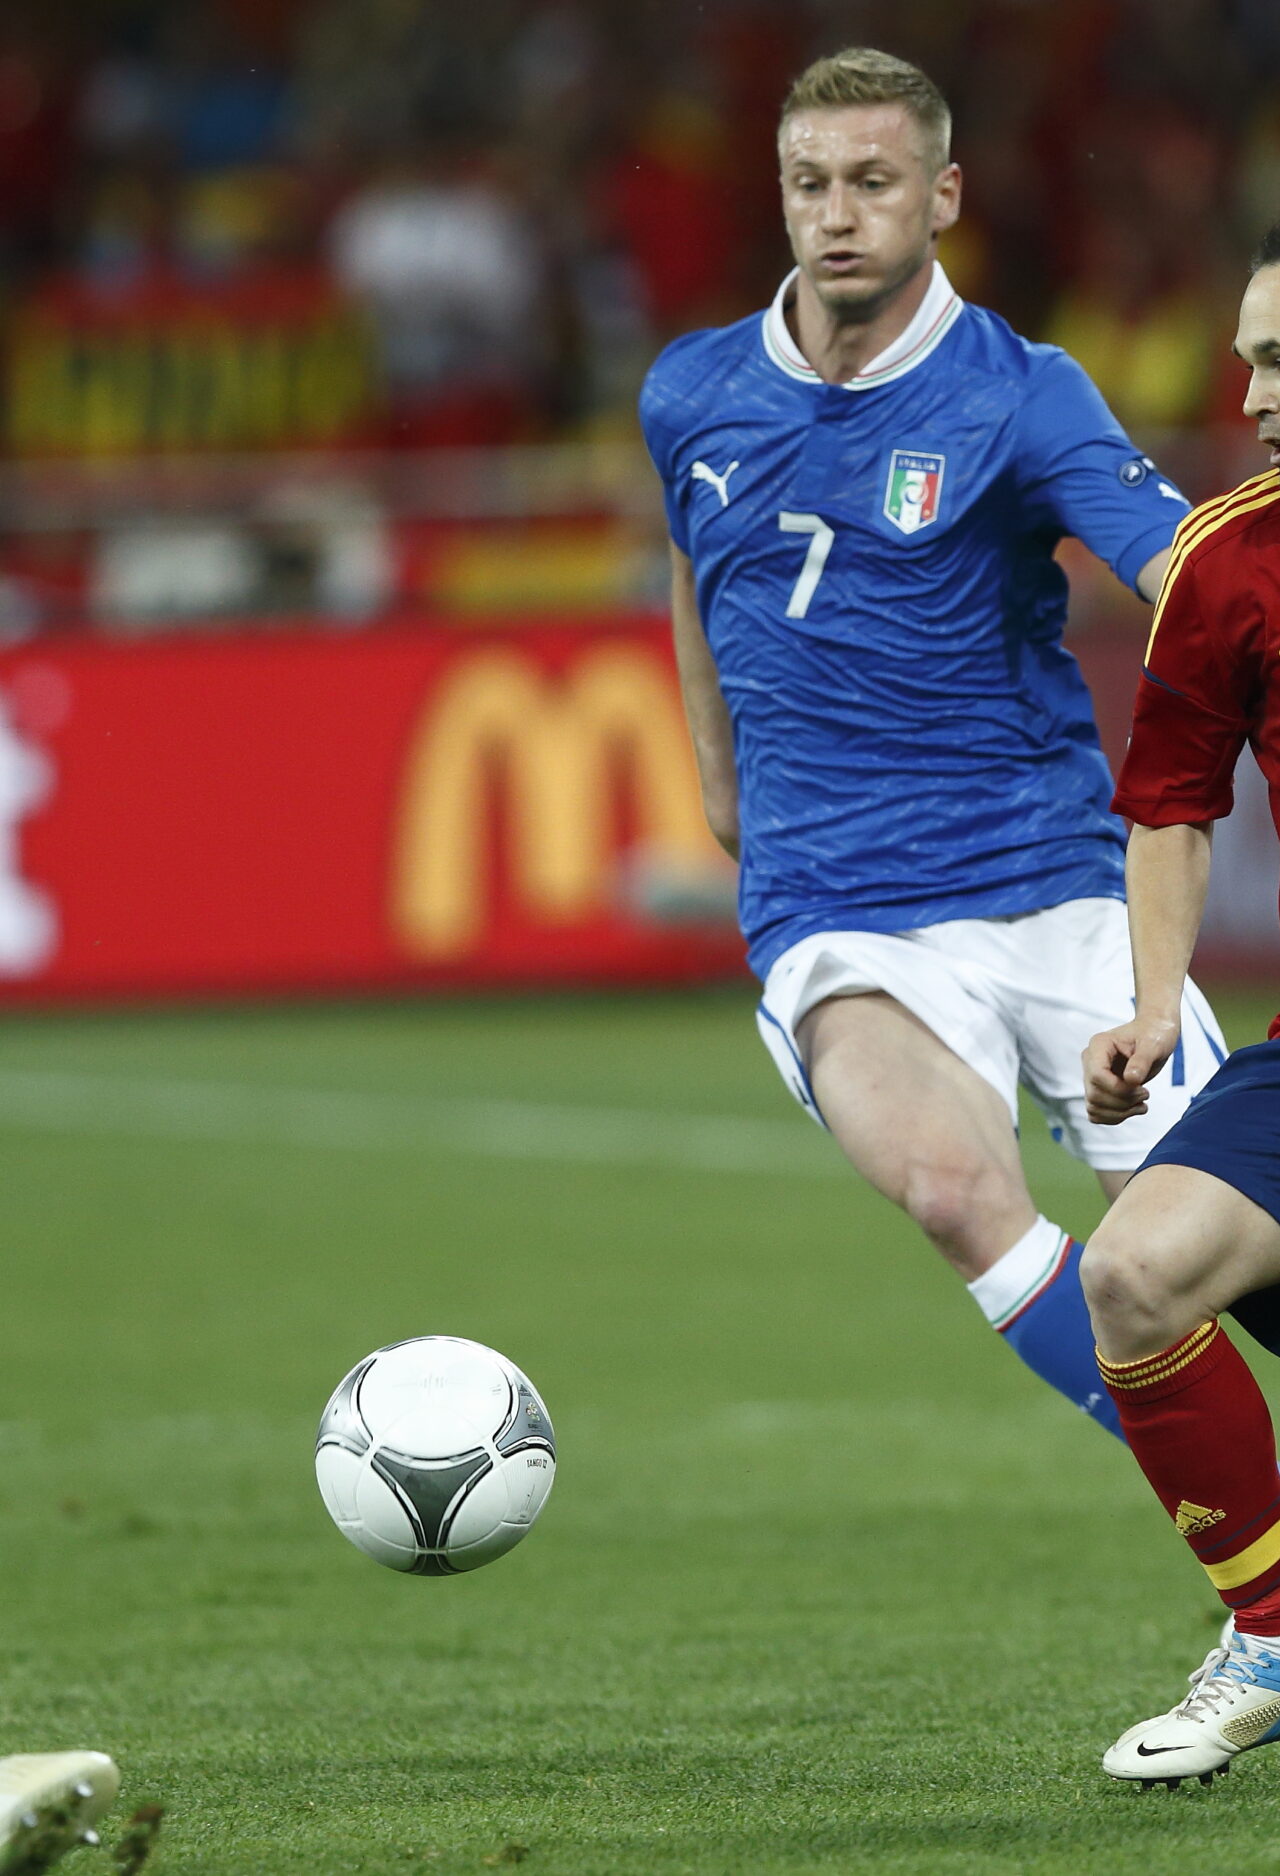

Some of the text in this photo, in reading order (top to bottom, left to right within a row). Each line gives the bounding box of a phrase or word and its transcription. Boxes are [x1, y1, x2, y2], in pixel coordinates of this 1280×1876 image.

[898, 457, 937, 471] ITALIA
[778, 510, 835, 619] 7
[526, 1459, 542, 1468] TANGO
